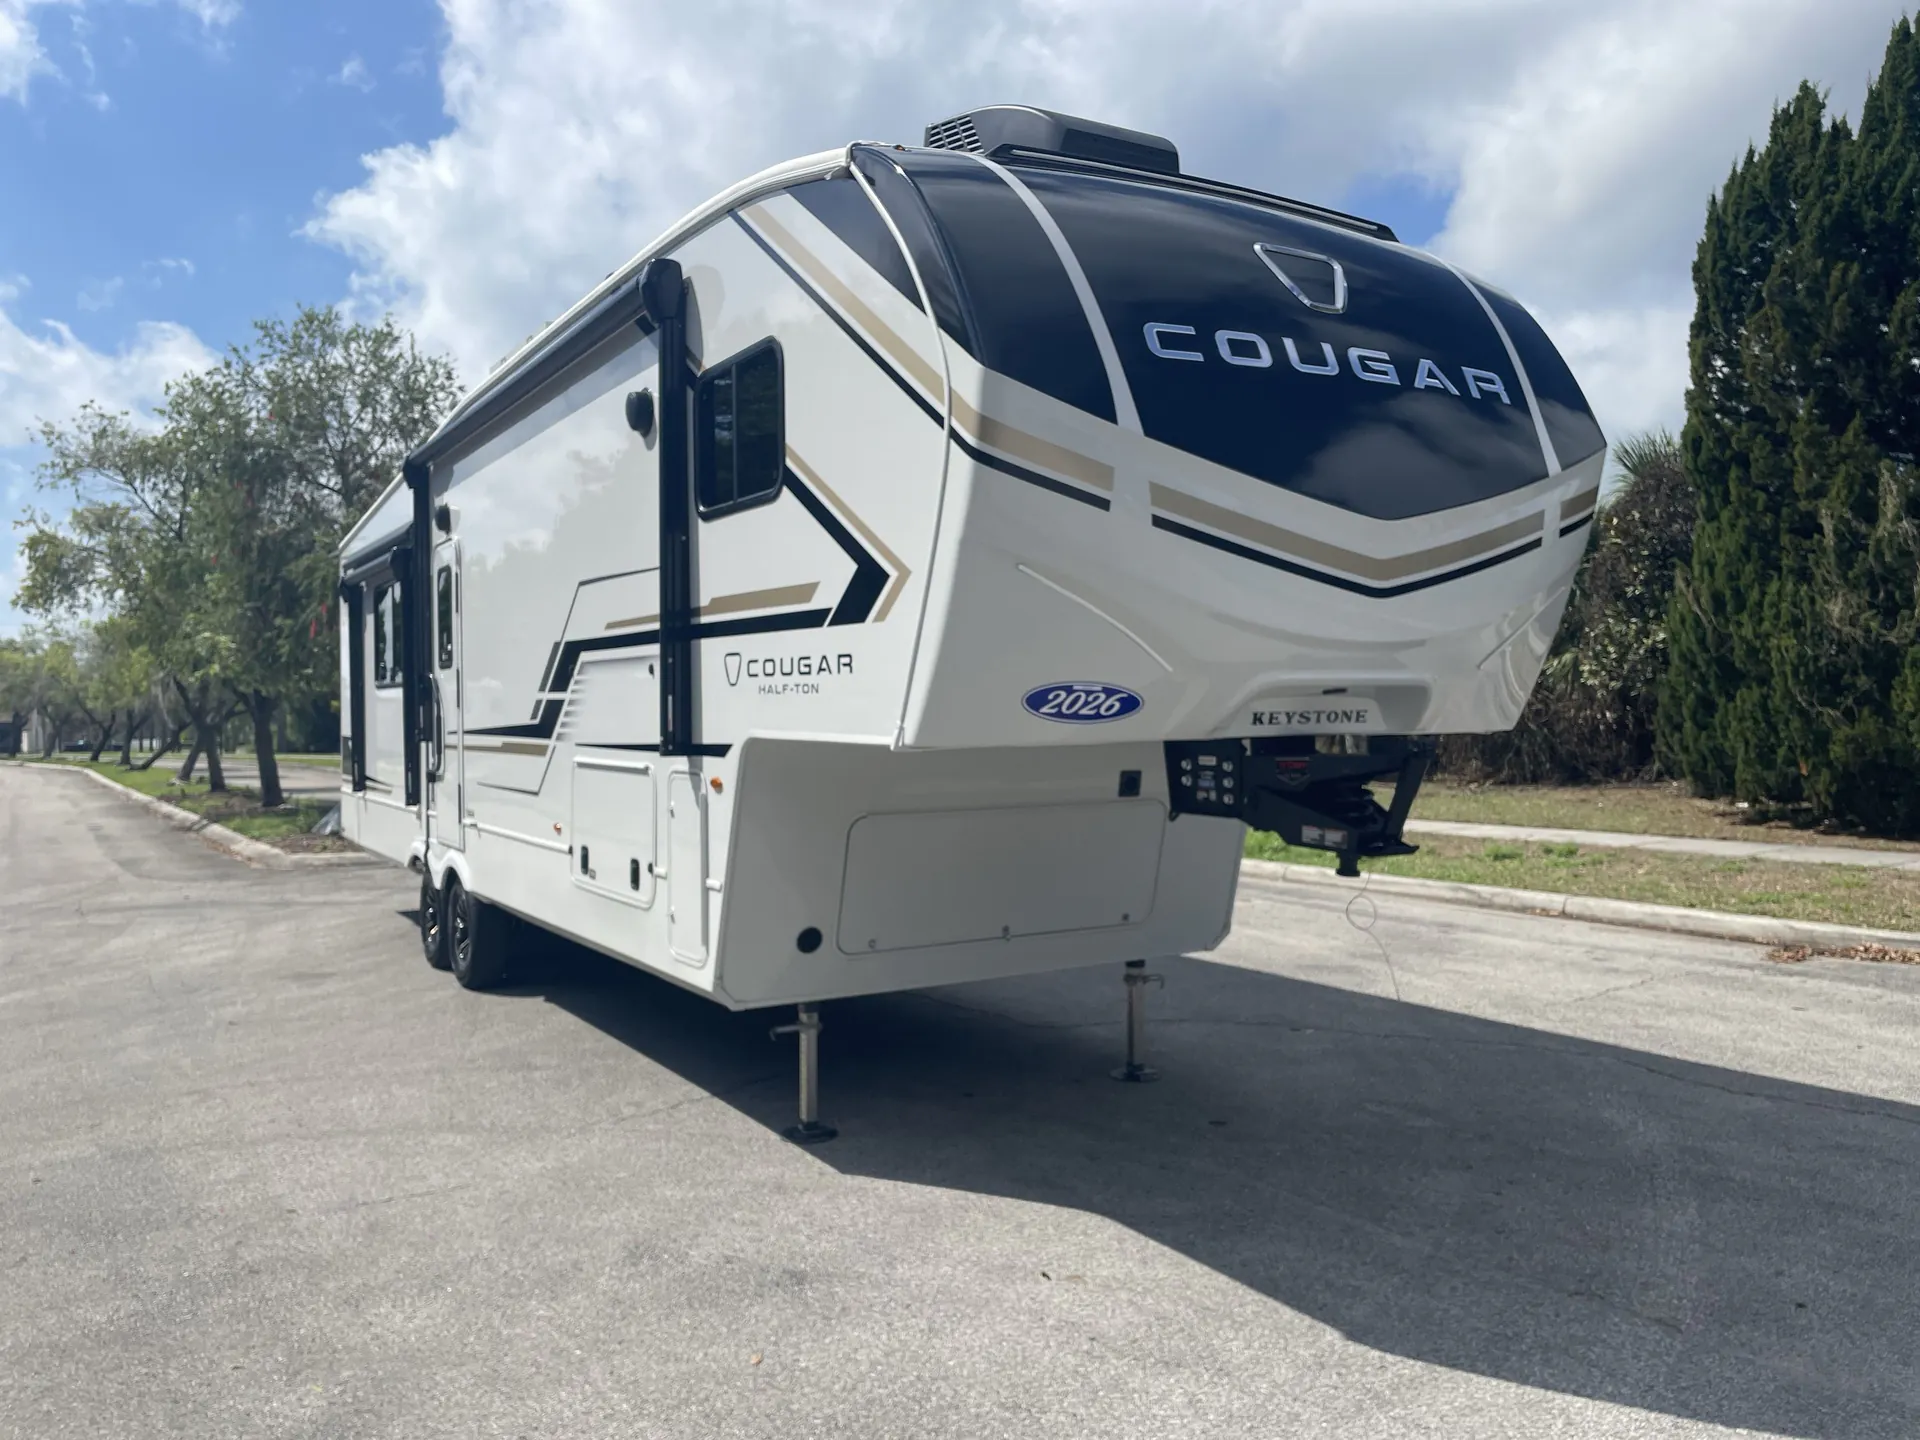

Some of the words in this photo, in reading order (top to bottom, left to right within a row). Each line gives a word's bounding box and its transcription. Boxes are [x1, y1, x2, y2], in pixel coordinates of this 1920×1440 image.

[1143, 322, 1511, 404] COUGAR
[747, 654, 853, 677] COUGAR
[758, 683, 819, 695] HALF-TON
[1038, 690, 1128, 716] 2026
[1251, 709, 1368, 726] KEYSTONE
